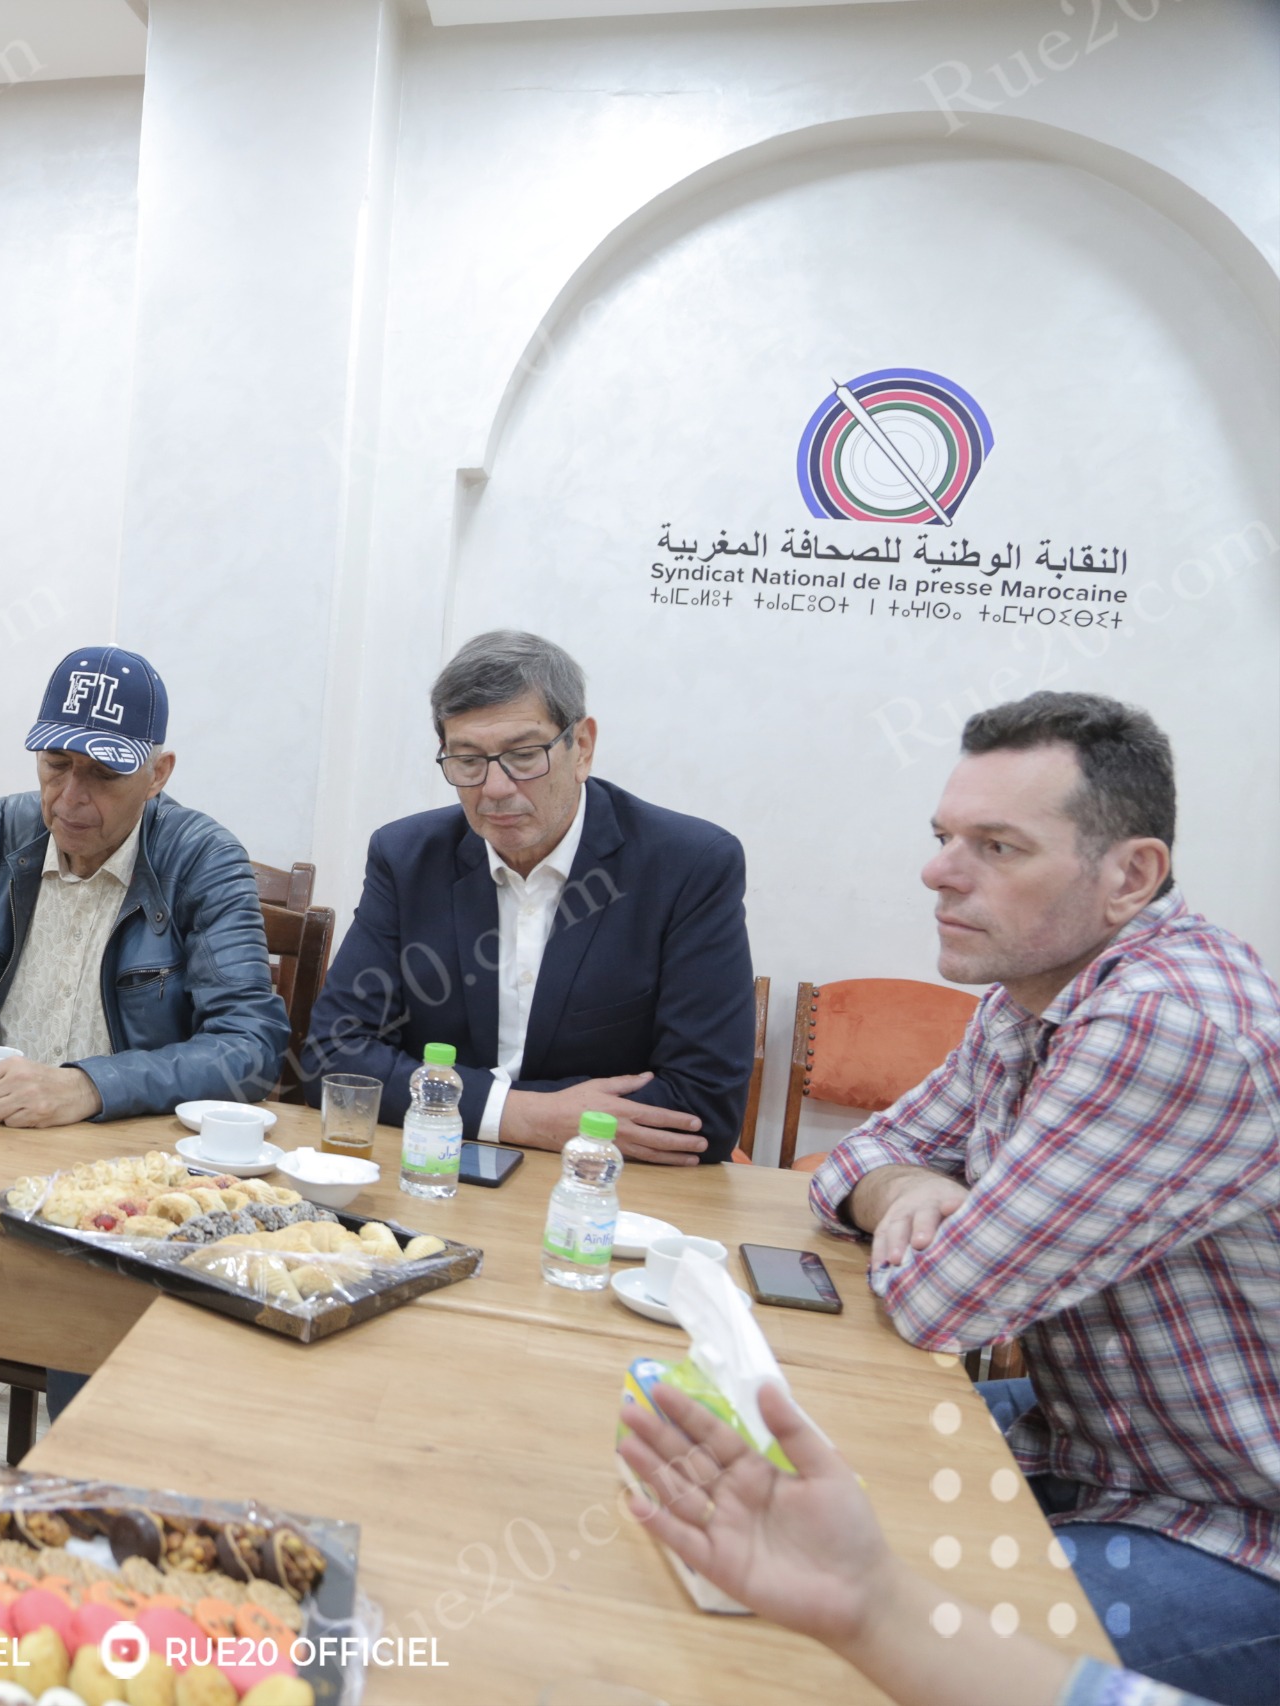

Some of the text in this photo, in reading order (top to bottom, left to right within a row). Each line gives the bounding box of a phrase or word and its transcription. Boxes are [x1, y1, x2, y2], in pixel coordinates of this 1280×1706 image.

[657, 522, 1128, 580] النقابة الوطنية للصحافة المغربية
[650, 562, 1128, 604] Syndicat National de la presse Marocaine
[62, 671, 124, 725] FL
